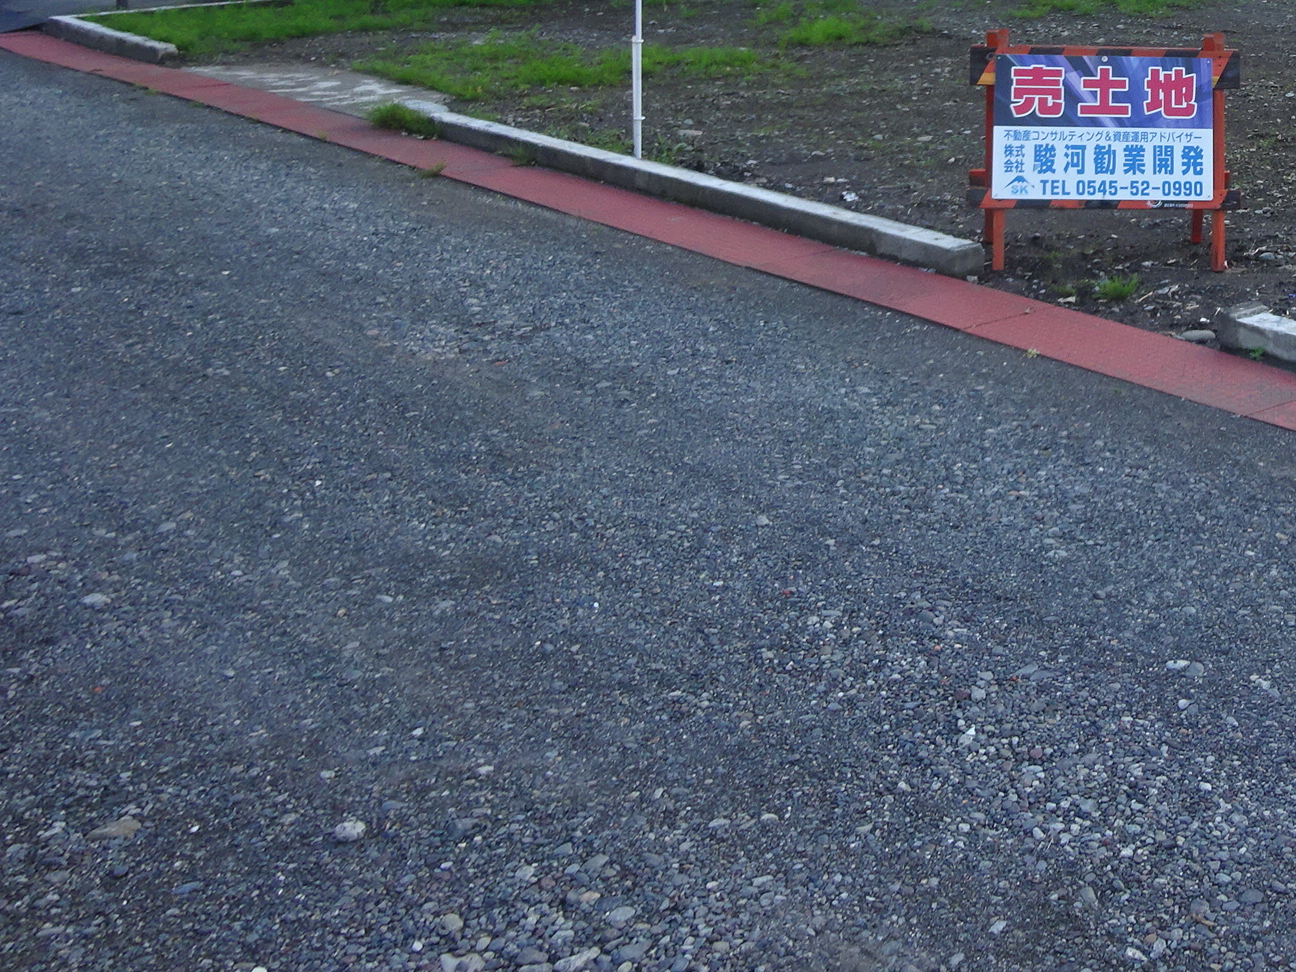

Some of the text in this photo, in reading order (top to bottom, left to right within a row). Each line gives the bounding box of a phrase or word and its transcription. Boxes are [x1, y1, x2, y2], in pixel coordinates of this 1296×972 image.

[1011, 64, 1198, 118] 売土地
[1033, 143, 1204, 176] 駿河勧業開発
[1011, 185, 1029, 195] SK
[1040, 179, 1204, 197] TEL 0545-52-0990
